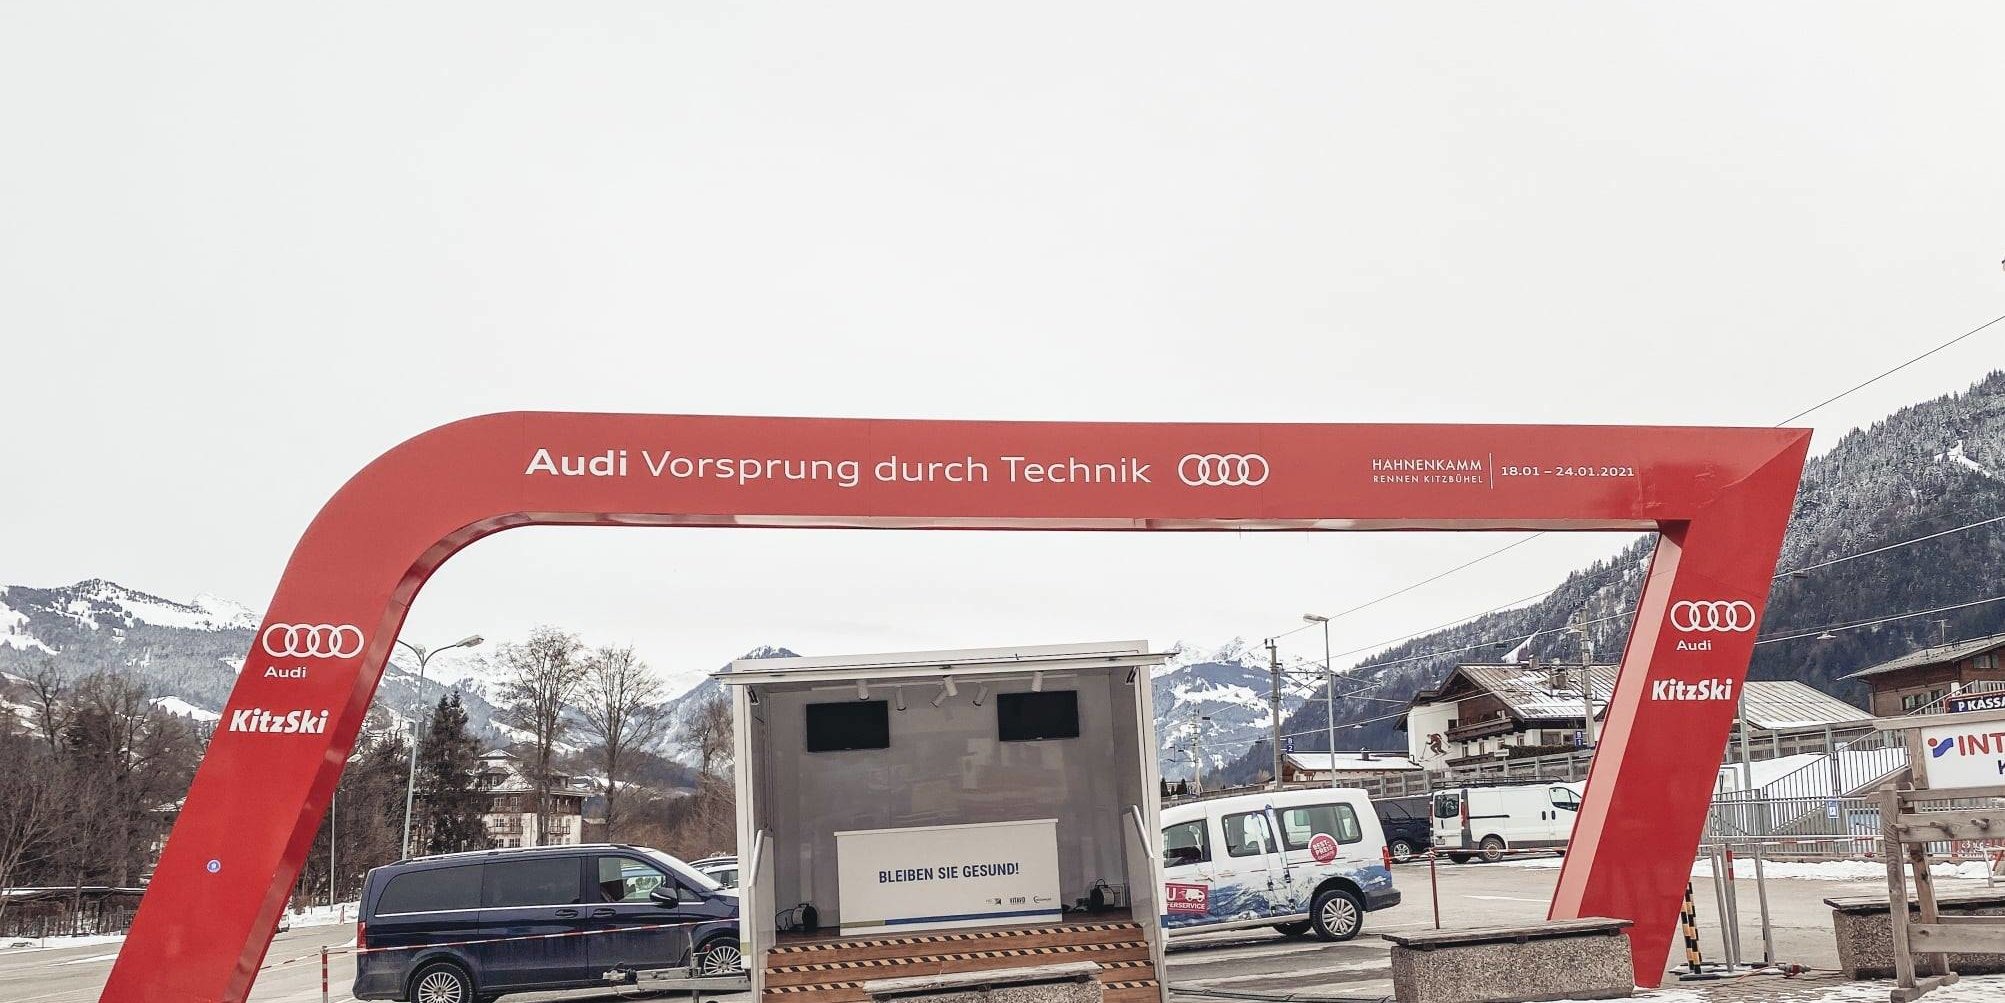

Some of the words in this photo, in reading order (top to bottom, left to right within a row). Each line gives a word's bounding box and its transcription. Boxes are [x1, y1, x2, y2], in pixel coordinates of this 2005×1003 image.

[525, 448, 627, 477] Audi
[641, 450, 860, 487] Vorsprung
[874, 456, 988, 482] durch
[1001, 456, 1152, 483] Technik
[1372, 459, 1482, 471] HAHNENKAMM
[1501, 466, 1540, 476] 18.01
[1555, 466, 1635, 477] 24.01.2021
[1373, 475, 1419, 483] RENNEN
[1424, 474, 1483, 483] KITZBÜHEL
[1676, 640, 1712, 651] Audi
[264, 666, 307, 678] Audi
[1652, 678, 1733, 701] KitzSki
[1958, 701, 1965, 711] P
[229, 708, 329, 734] KitzSki
[1958, 732, 2005, 756] INT
[879, 868, 934, 883] BLEIBEN
[938, 866, 959, 880] SIE
[963, 862, 1020, 878] GESUND!
